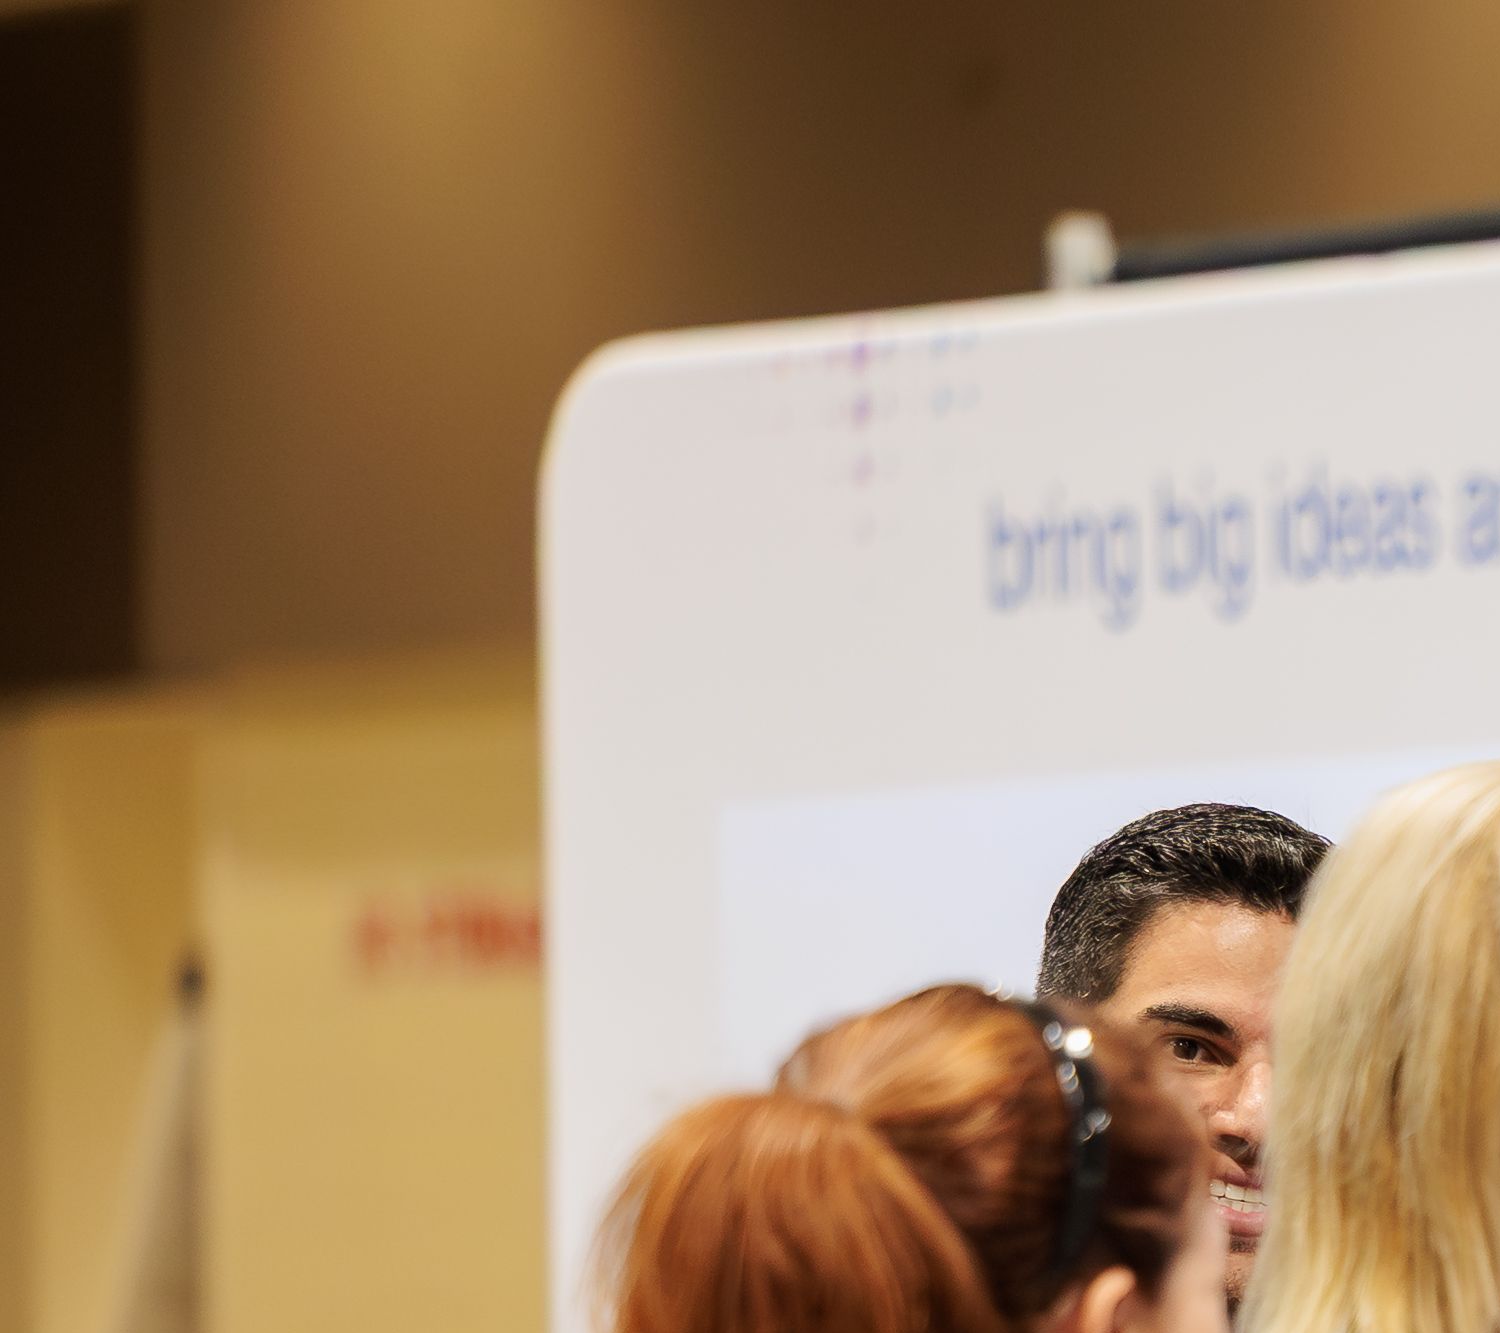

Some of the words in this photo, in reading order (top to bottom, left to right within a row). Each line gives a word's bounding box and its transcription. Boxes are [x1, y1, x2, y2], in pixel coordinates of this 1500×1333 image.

[985, 492, 1143, 631] bring
[1156, 472, 1252, 622] big
[1270, 460, 1440, 582] ideas
